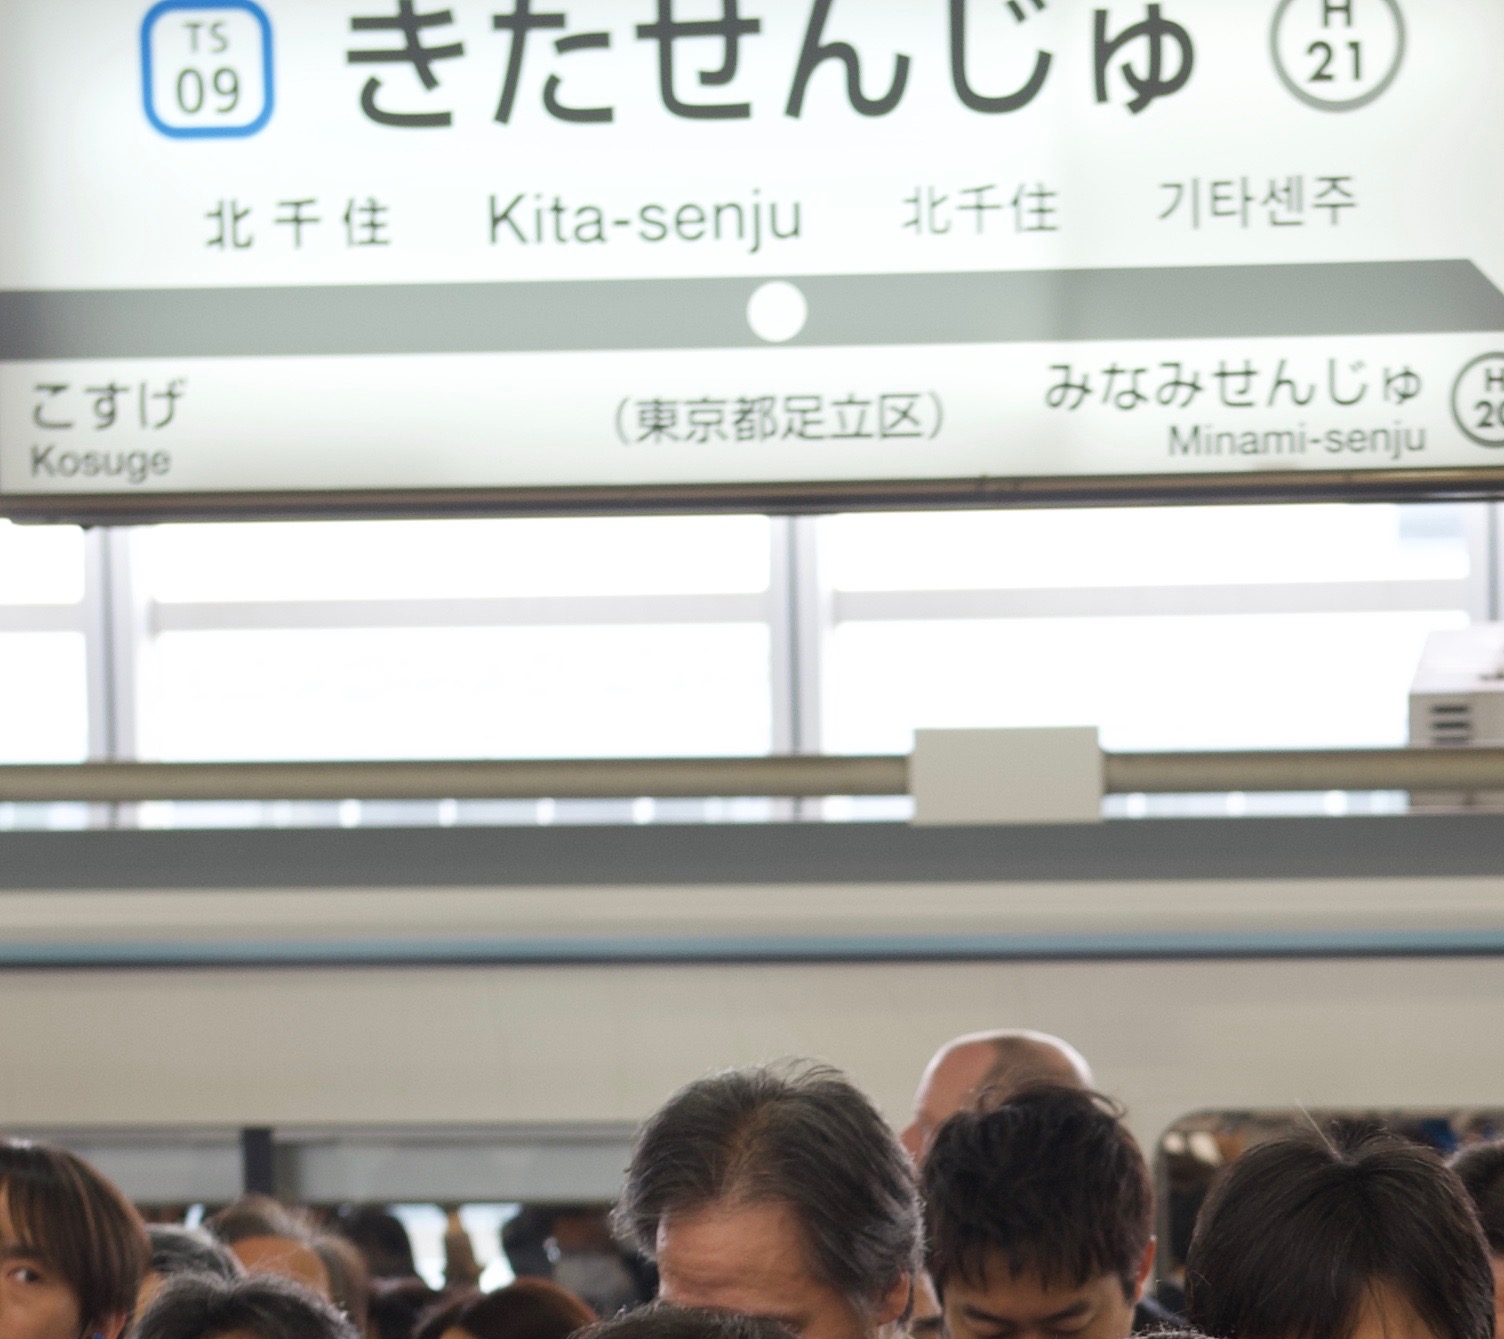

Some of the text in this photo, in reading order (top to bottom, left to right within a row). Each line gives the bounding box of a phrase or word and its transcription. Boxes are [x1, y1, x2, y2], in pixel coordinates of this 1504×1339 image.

[183, 21, 229, 54] TS
[1322, 0, 1351, 28] H
[346, 0, 1195, 128] きたせんじゅ
[1306, 41, 1364, 83] 21
[176, 67, 241, 114] 09
[204, 197, 392, 250] 北千住
[487, 193, 803, 254] Kita-senju
[901, 182, 1058, 237] 北千住
[1157, 174, 1358, 230] 기타센주
[31, 377, 186, 430] こすげ
[1043, 357, 1422, 411] みなみせんじゅ
[30, 444, 172, 484] Kosuge
[1166, 423, 1426, 463] Minami-senju
